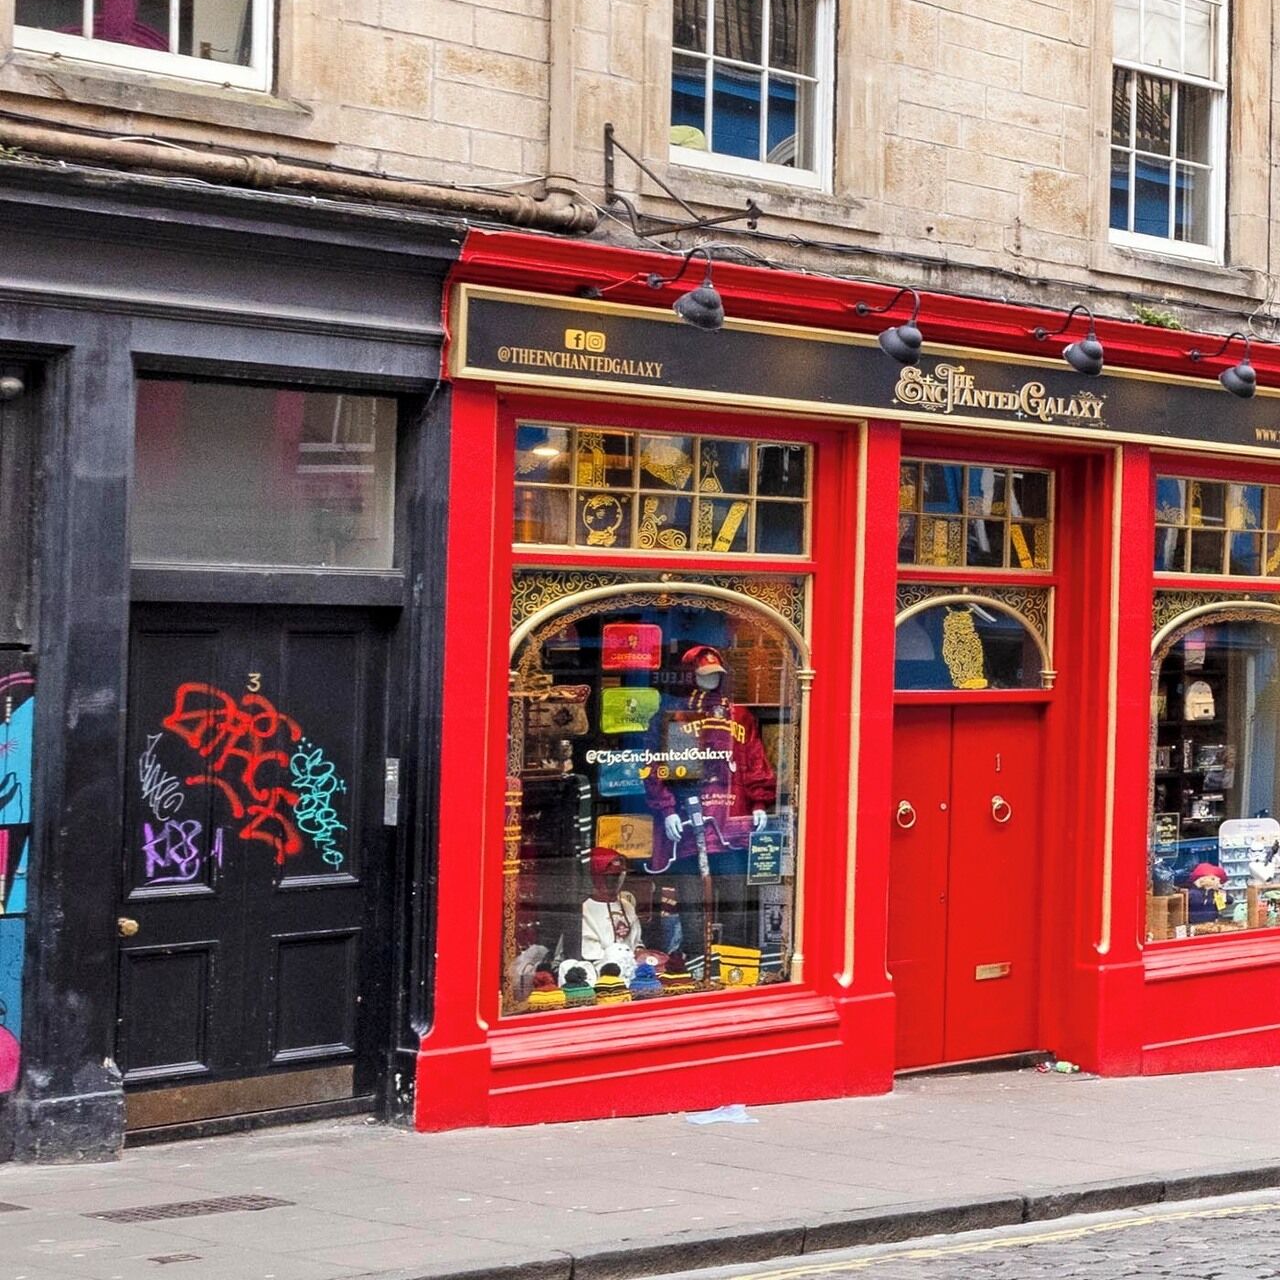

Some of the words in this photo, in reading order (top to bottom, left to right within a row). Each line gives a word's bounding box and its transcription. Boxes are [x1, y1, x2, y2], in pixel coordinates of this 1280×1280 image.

[497, 346, 663, 379] @THEENCHANTEDGALAXY
[247, 673, 263, 693] 3
[585, 747, 733, 765] @TheEnchantedGalaxy
